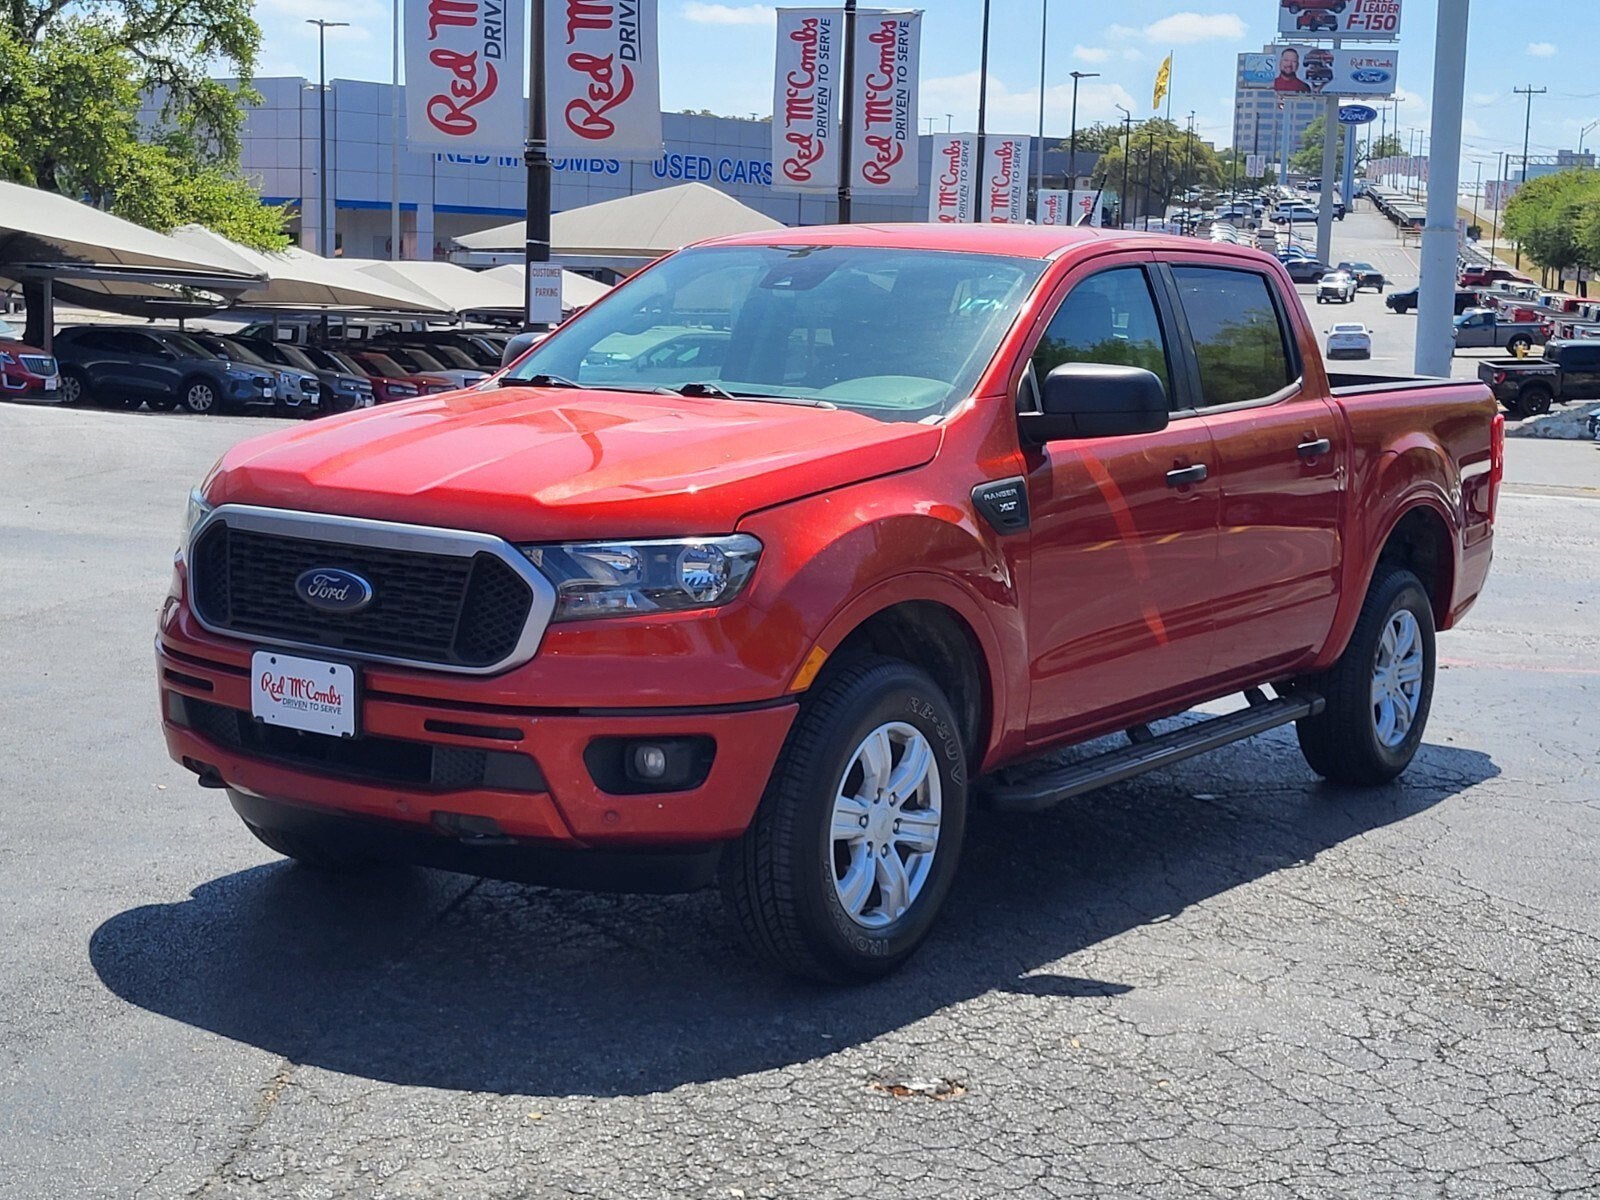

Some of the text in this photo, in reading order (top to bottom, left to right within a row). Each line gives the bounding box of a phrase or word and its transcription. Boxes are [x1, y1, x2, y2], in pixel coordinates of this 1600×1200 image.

[484, 0, 502, 60] DRIV
[619, 0, 637, 62] DRIV
[1346, 14, 1397, 31] F-150
[1363, 3, 1400, 14] LEADER
[427, 49, 498, 136] Red
[565, 53, 634, 140] Red
[783, 18, 824, 182] Red McCombs
[816, 18, 831, 138] DRIVEN TO SERVE
[895, 21, 910, 140] DRIVEN TO SERVE
[862, 20, 903, 184] Red McCombs
[1339, 108, 1367, 122] Ford
[654, 153, 712, 181] USED
[719, 158, 773, 185] CARS
[958, 140, 970, 219] DRIVEN TO SERVE
[1010, 141, 1022, 220] DRIVEN TO SERVE
[1043, 195, 1056, 225] Combs
[983, 488, 1018, 501] RANGER
[999, 501, 1017, 512] XLT
[307, 574, 350, 601] Ford
[261, 672, 342, 706] Red McCombs
[282, 697, 342, 715] DRIVEN TO SERVE
